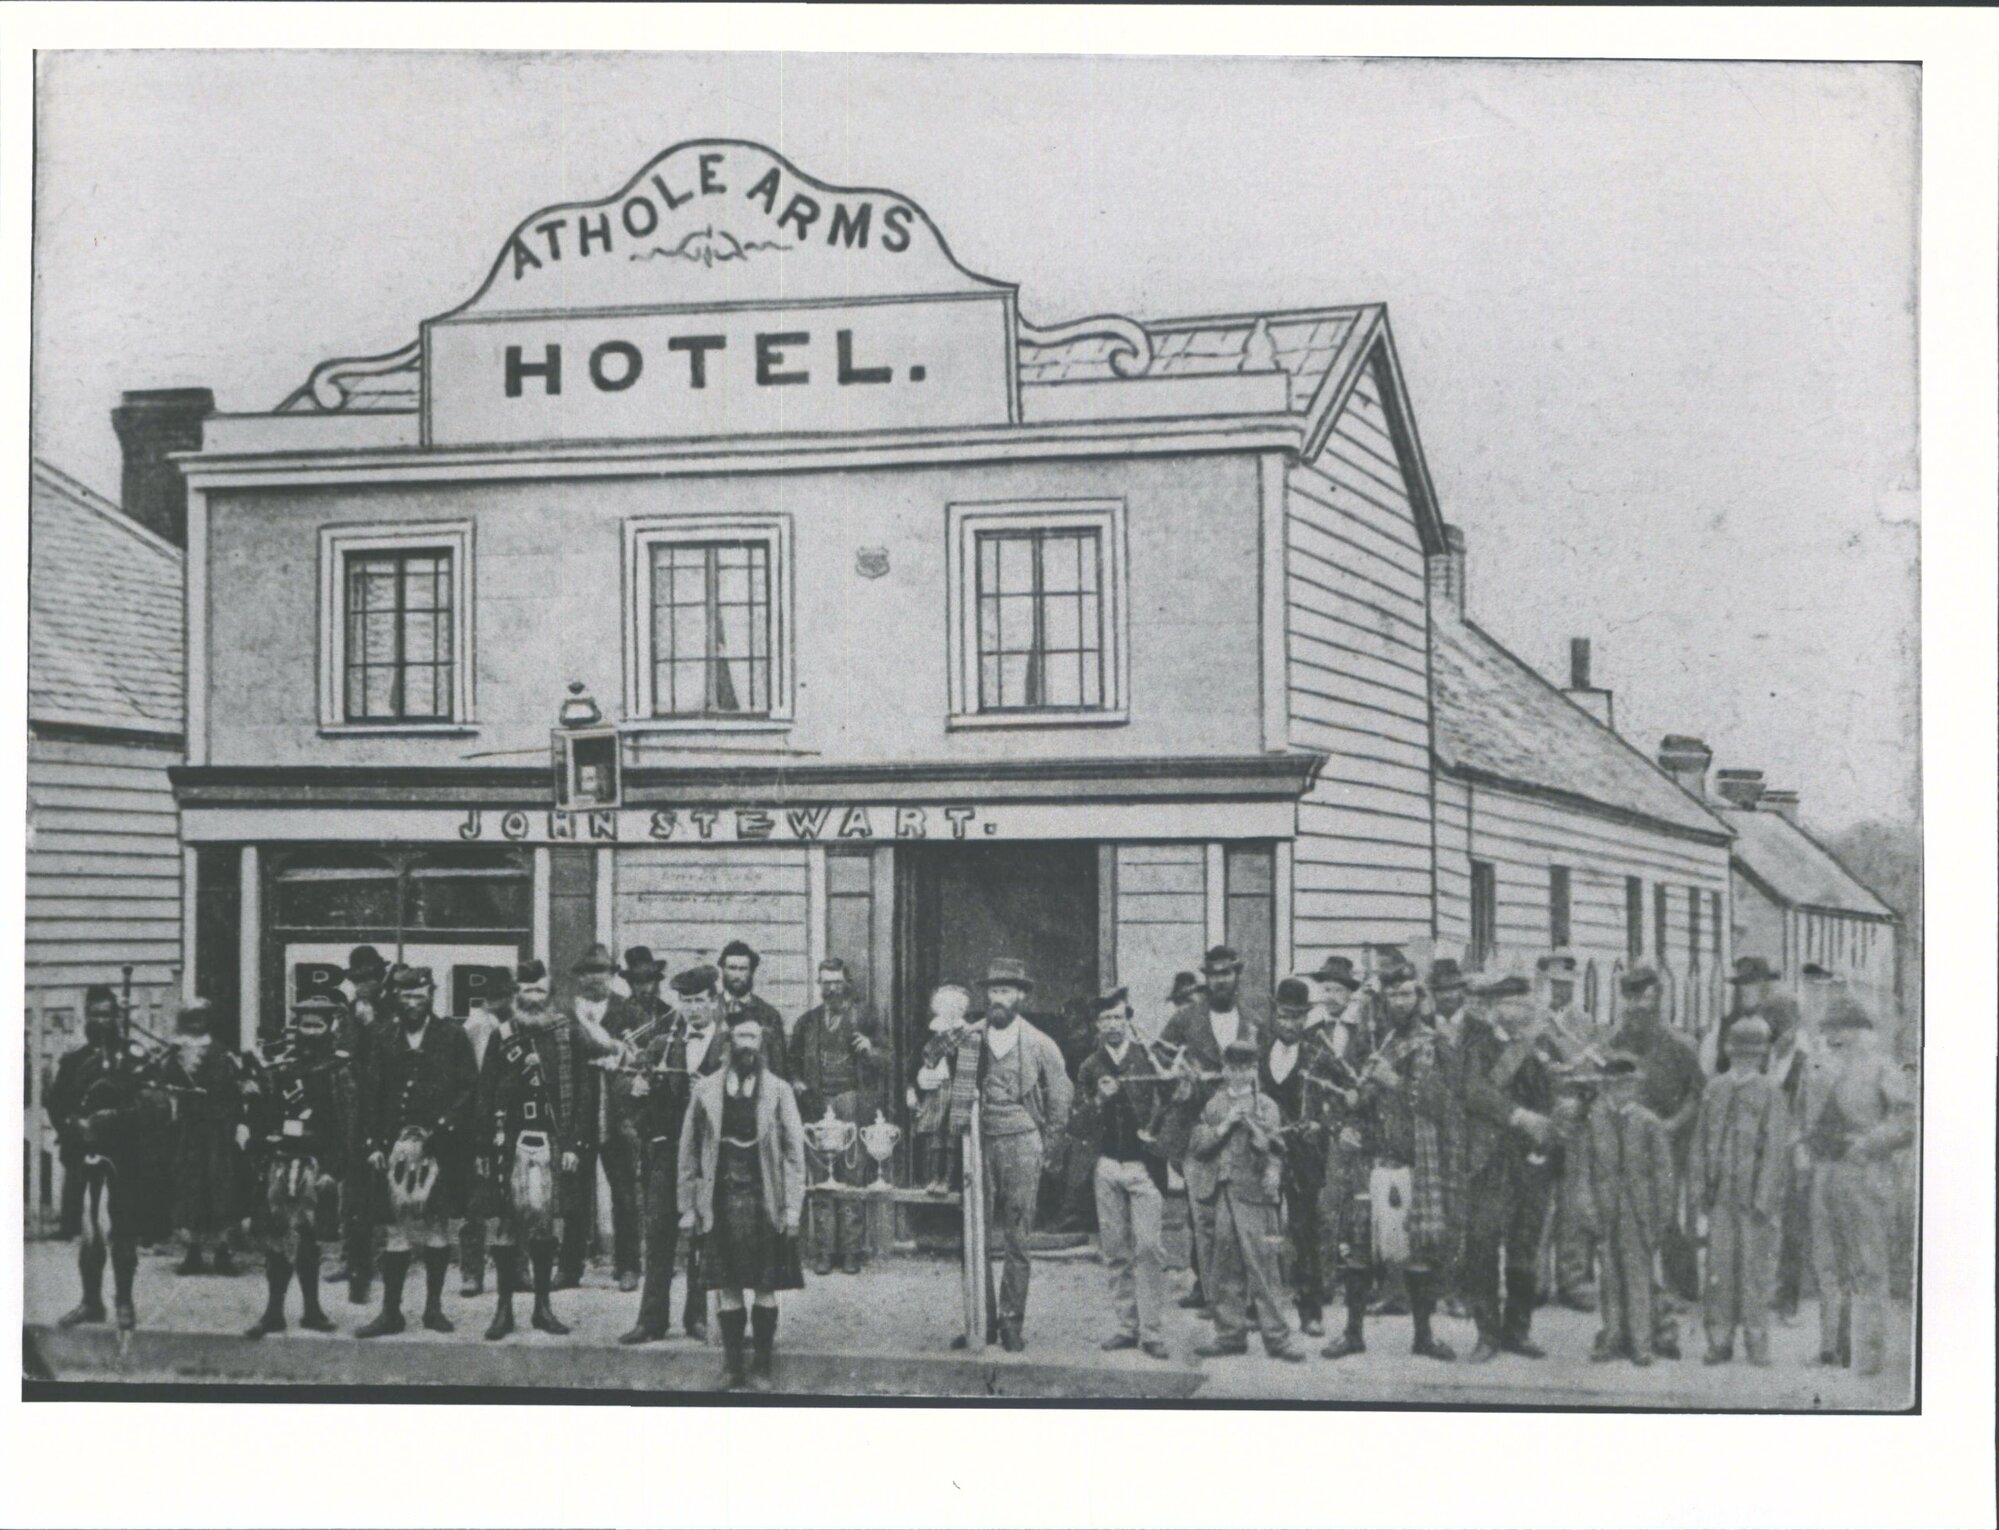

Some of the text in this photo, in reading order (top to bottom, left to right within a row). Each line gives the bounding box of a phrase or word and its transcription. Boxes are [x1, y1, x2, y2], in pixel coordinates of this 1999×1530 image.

[509, 154, 914, 280] ATHOLE ARMS
[504, 329, 926, 398] HOTEL.
[459, 806, 998, 841] JOHN STEWART.
